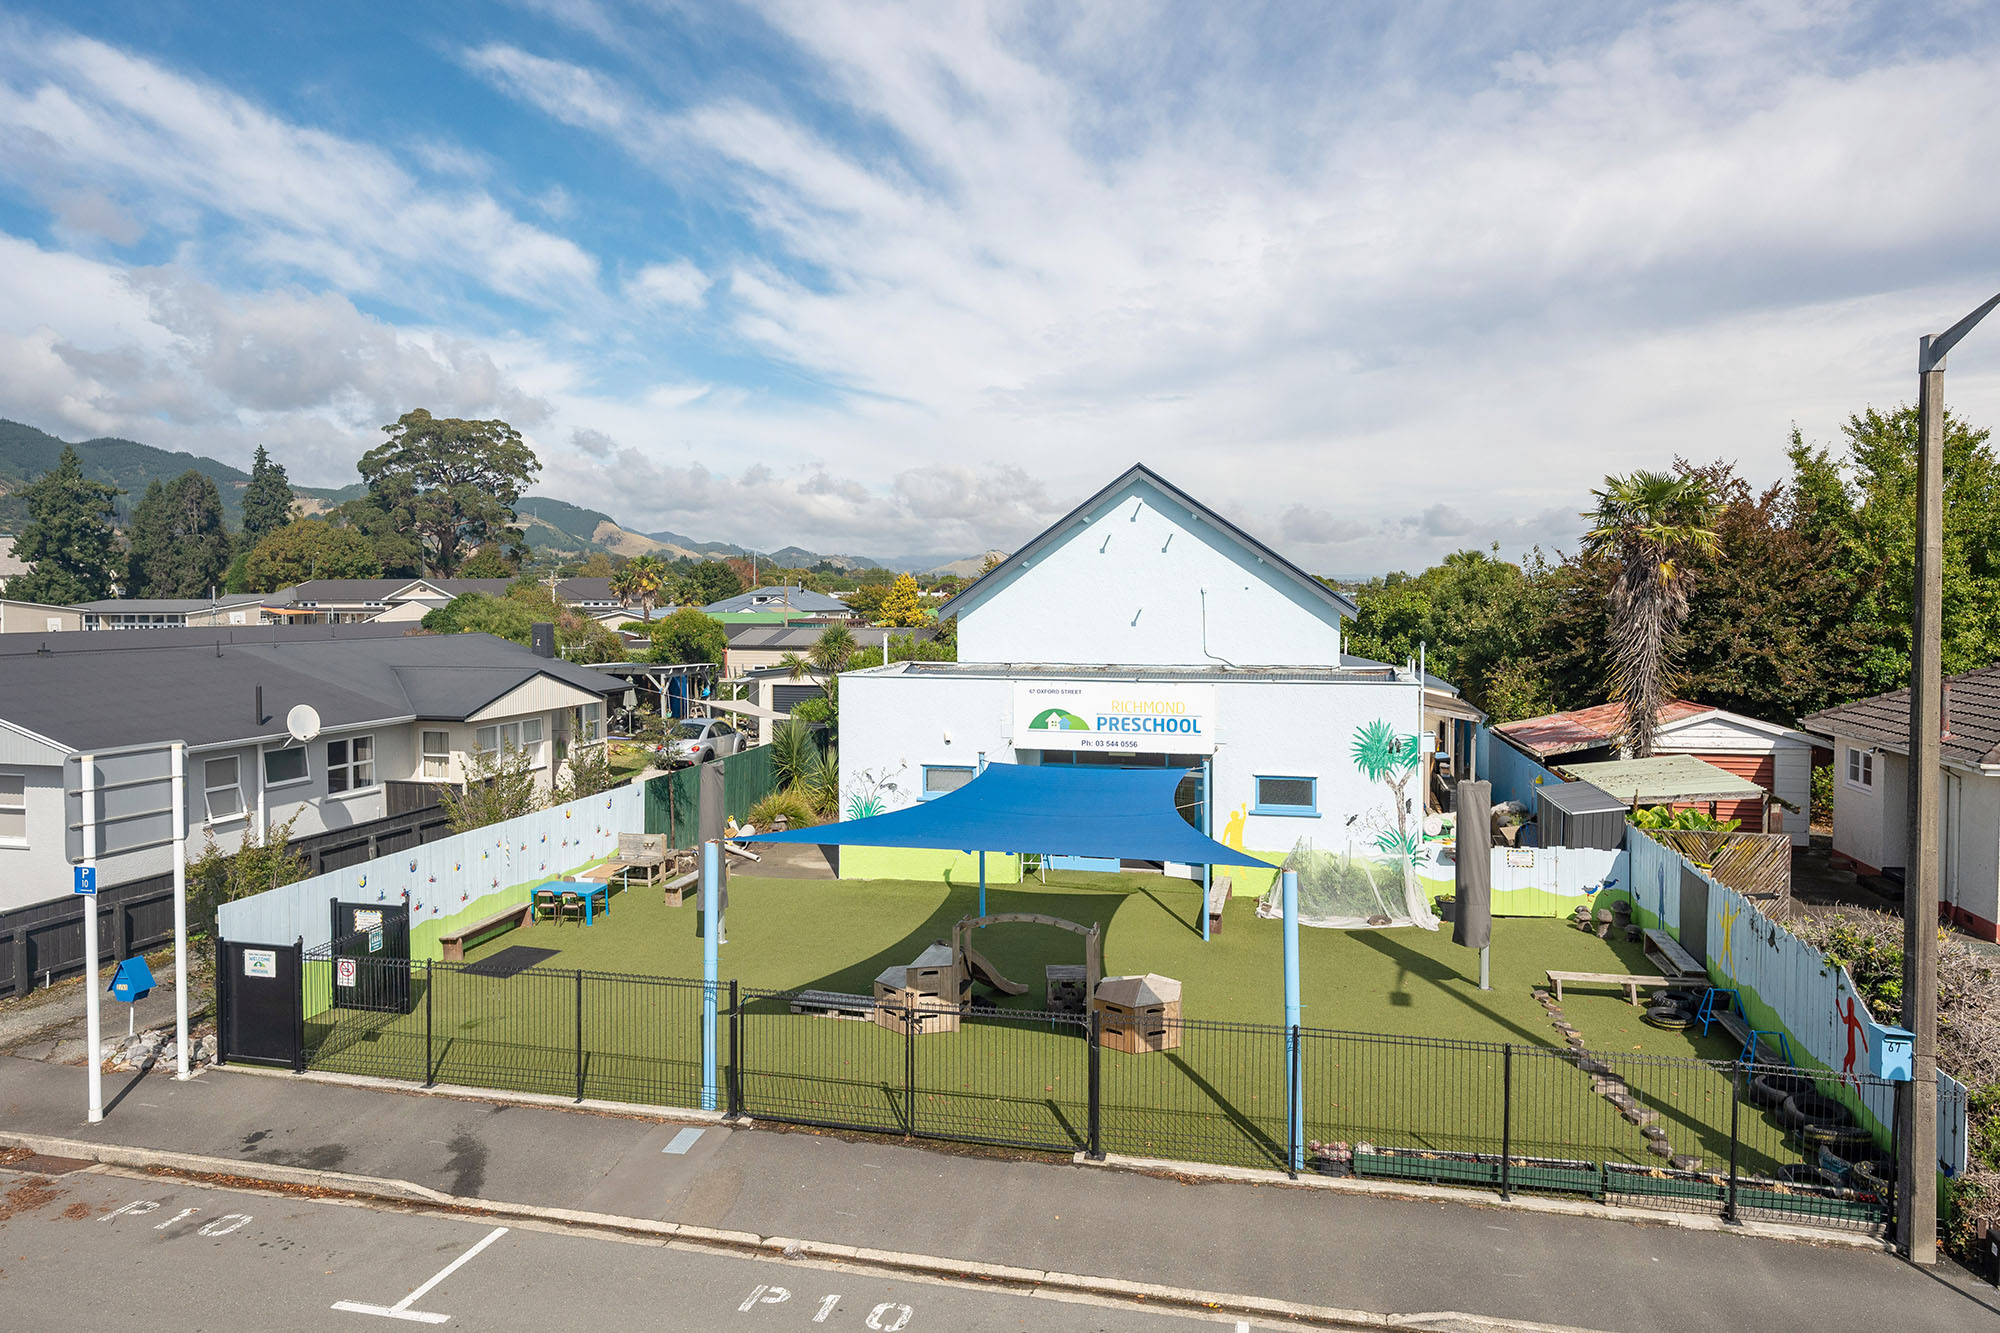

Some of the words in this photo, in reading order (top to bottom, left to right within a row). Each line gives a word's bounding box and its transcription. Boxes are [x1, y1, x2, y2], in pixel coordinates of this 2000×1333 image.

[1111, 699, 1186, 714] RICHMOND
[1097, 716, 1202, 734] PRESCHOOL
[1081, 739, 1094, 747] Ph:
[1120, 740, 1138, 748] 0556
[81, 868, 90, 879] P
[81, 879, 89, 888] 10
[1888, 1042, 1901, 1053] 67
